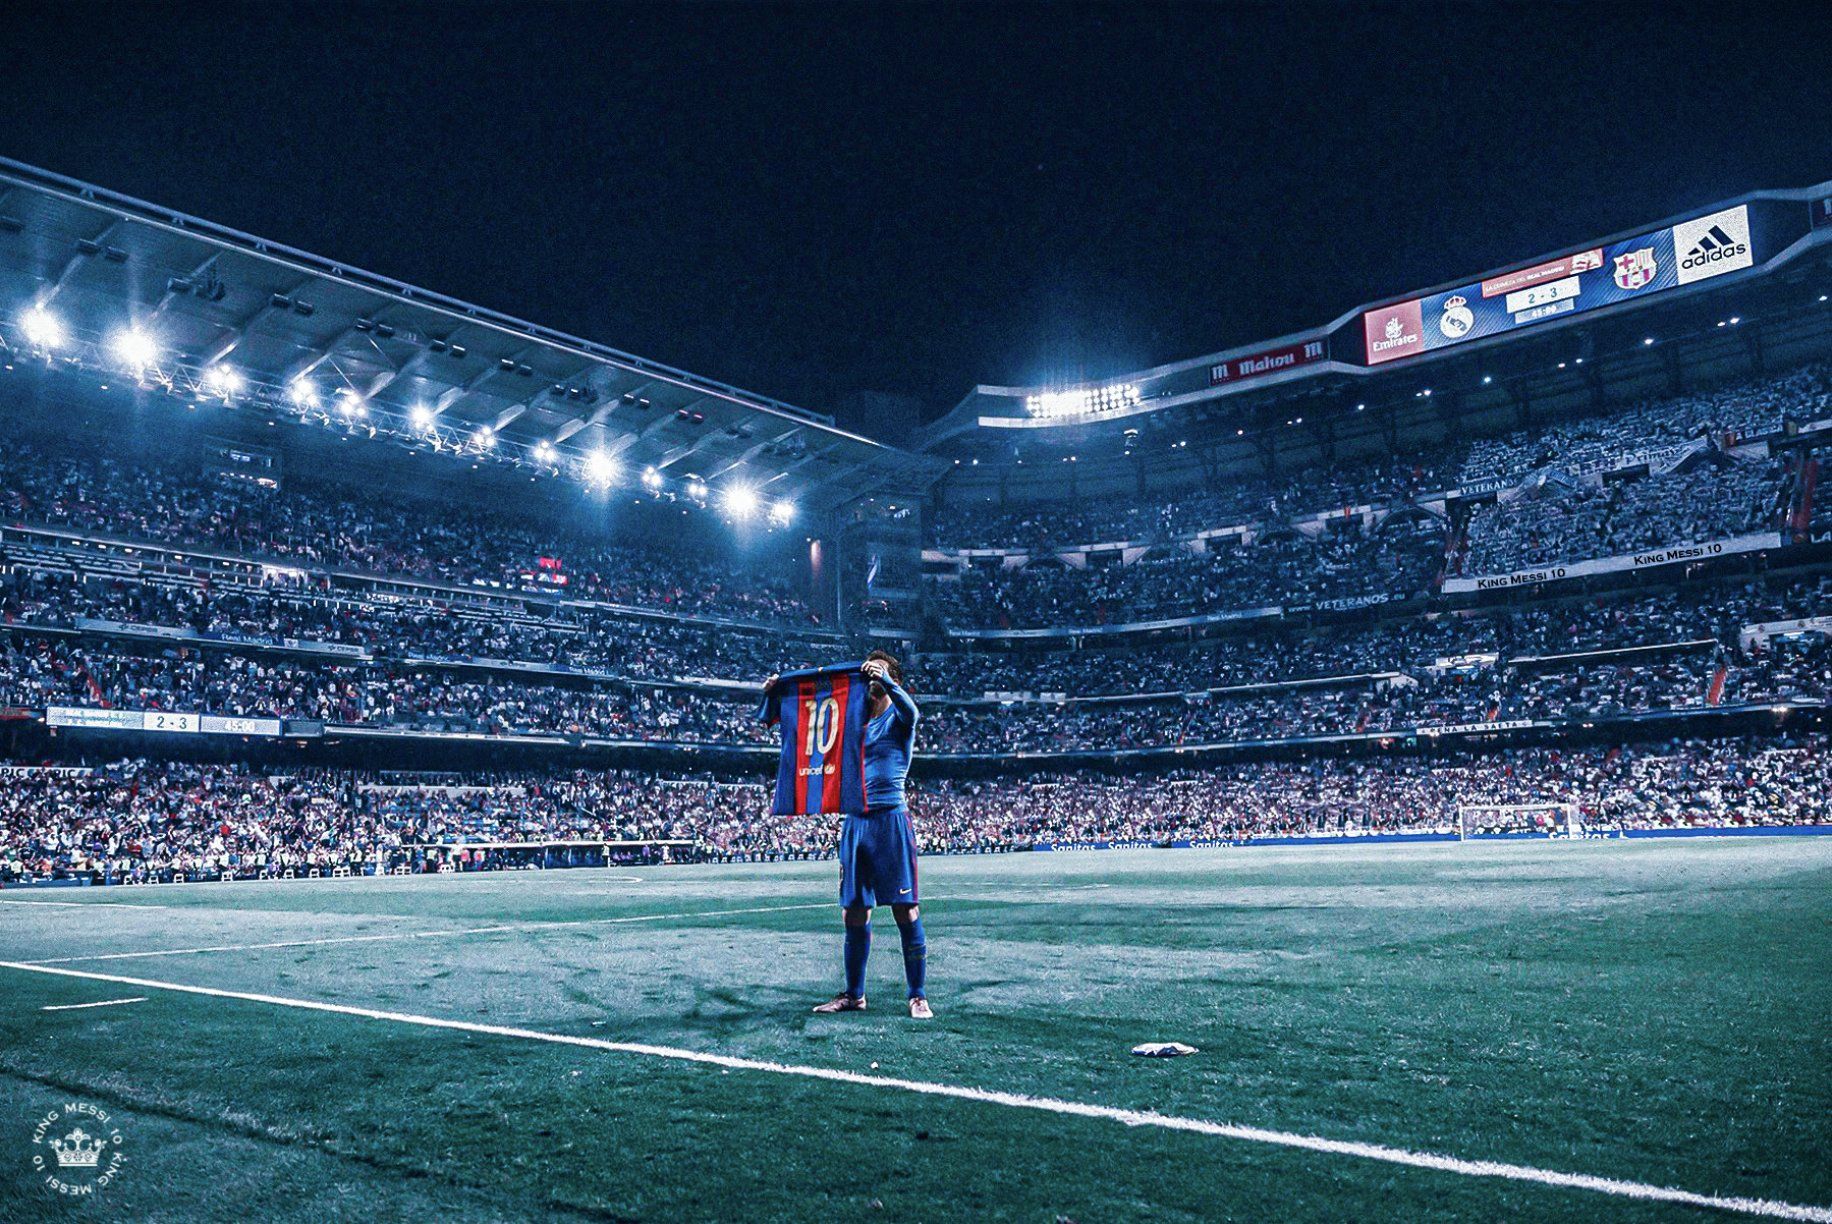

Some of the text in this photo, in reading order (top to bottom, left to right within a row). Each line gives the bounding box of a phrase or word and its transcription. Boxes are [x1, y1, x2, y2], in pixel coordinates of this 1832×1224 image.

[1681, 243, 1747, 270] adidas
[1528, 293, 1536, 304] 2
[1550, 287, 1557, 298] 3
[1373, 333, 1418, 352] Emirates
[1707, 543, 1722, 554] 10
[1551, 568, 1566, 578] 10
[1315, 592, 1390, 611] VETERANOS
[156, 716, 165, 729] 2
[179, 717, 188, 730] 3
[805, 697, 839, 756] 10
[1051, 843, 1096, 852] Sanitas
[1109, 841, 1153, 850] Sanitas
[1189, 840, 1235, 849] Sanitas
